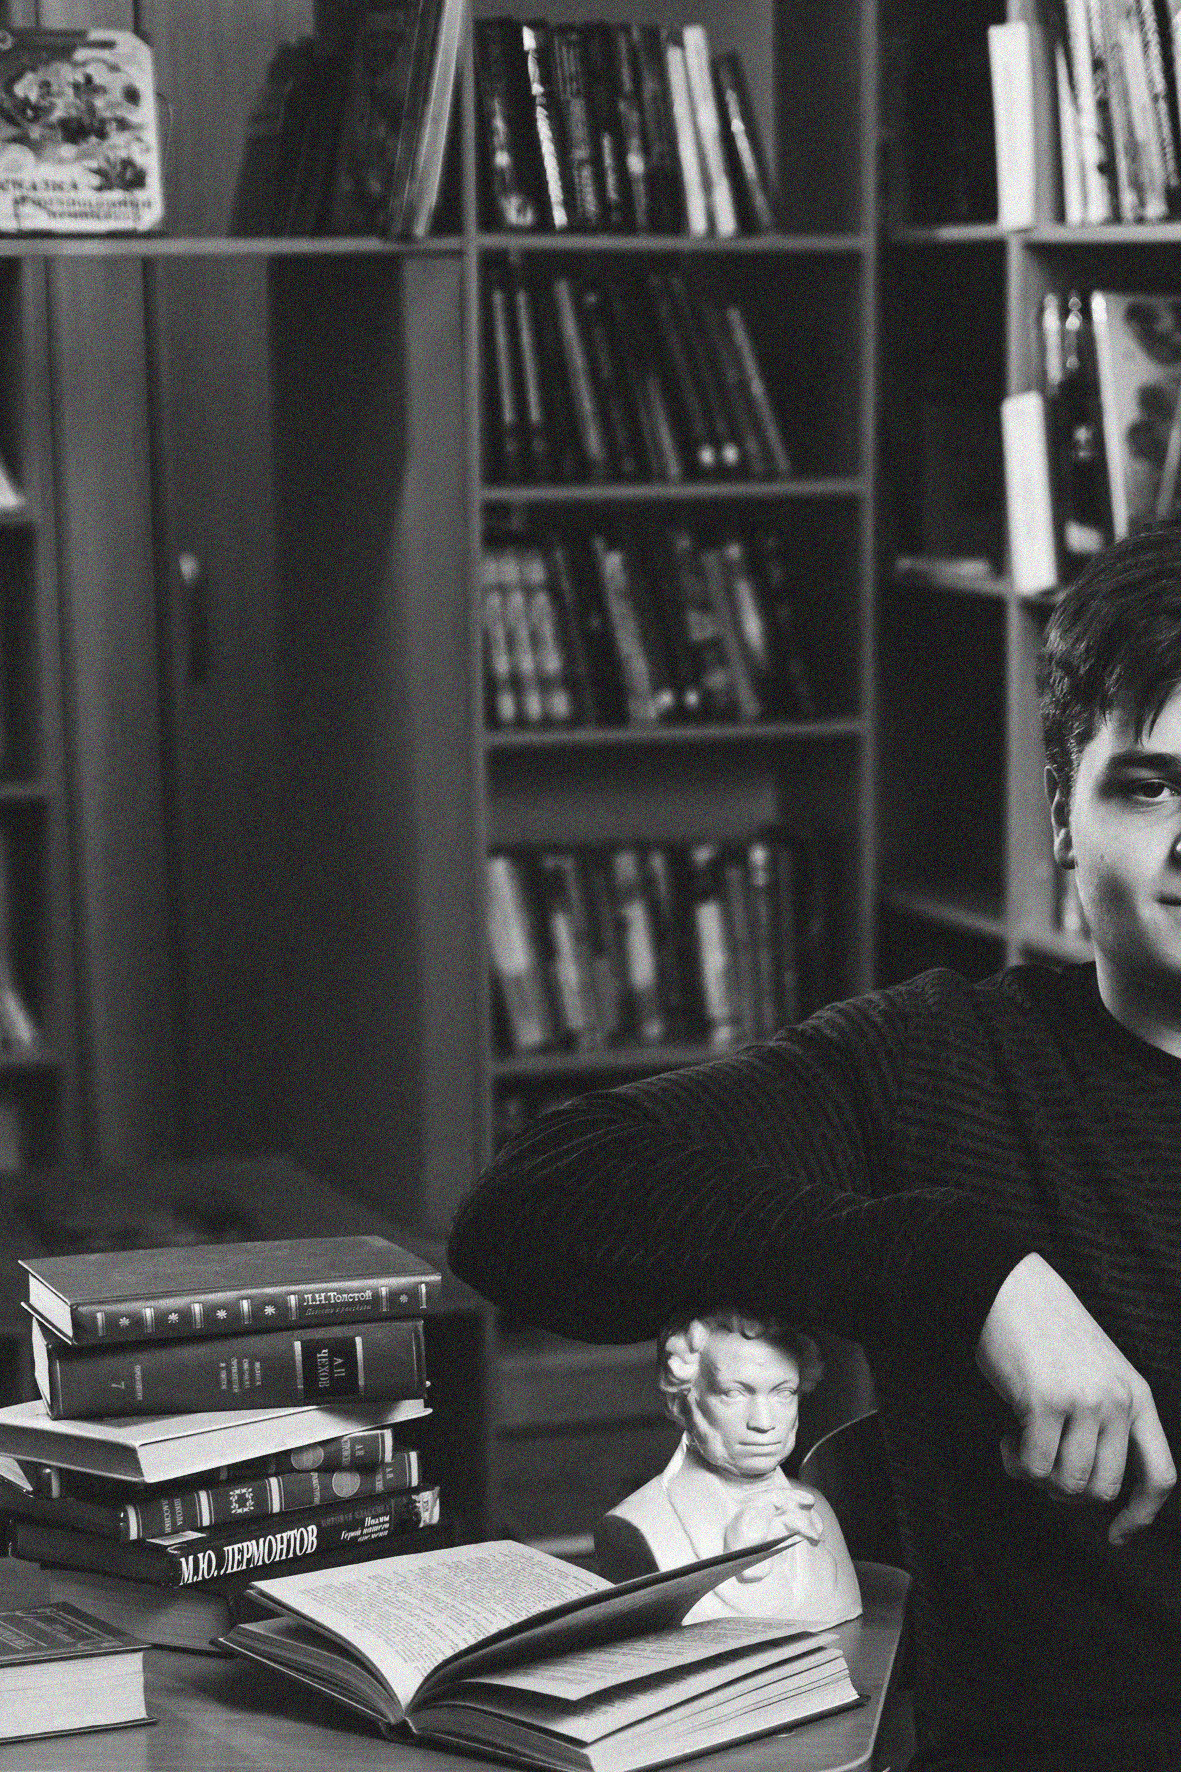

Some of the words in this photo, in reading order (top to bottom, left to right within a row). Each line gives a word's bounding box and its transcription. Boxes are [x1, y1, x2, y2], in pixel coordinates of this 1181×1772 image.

[110, 1380, 125, 1389] 7
[316, 1348, 330, 1388] ЧЕХОВ
[179, 1548, 218, 1587] М.Ю.
[220, 1524, 318, 1575] ЛЕРМОНТОВ
